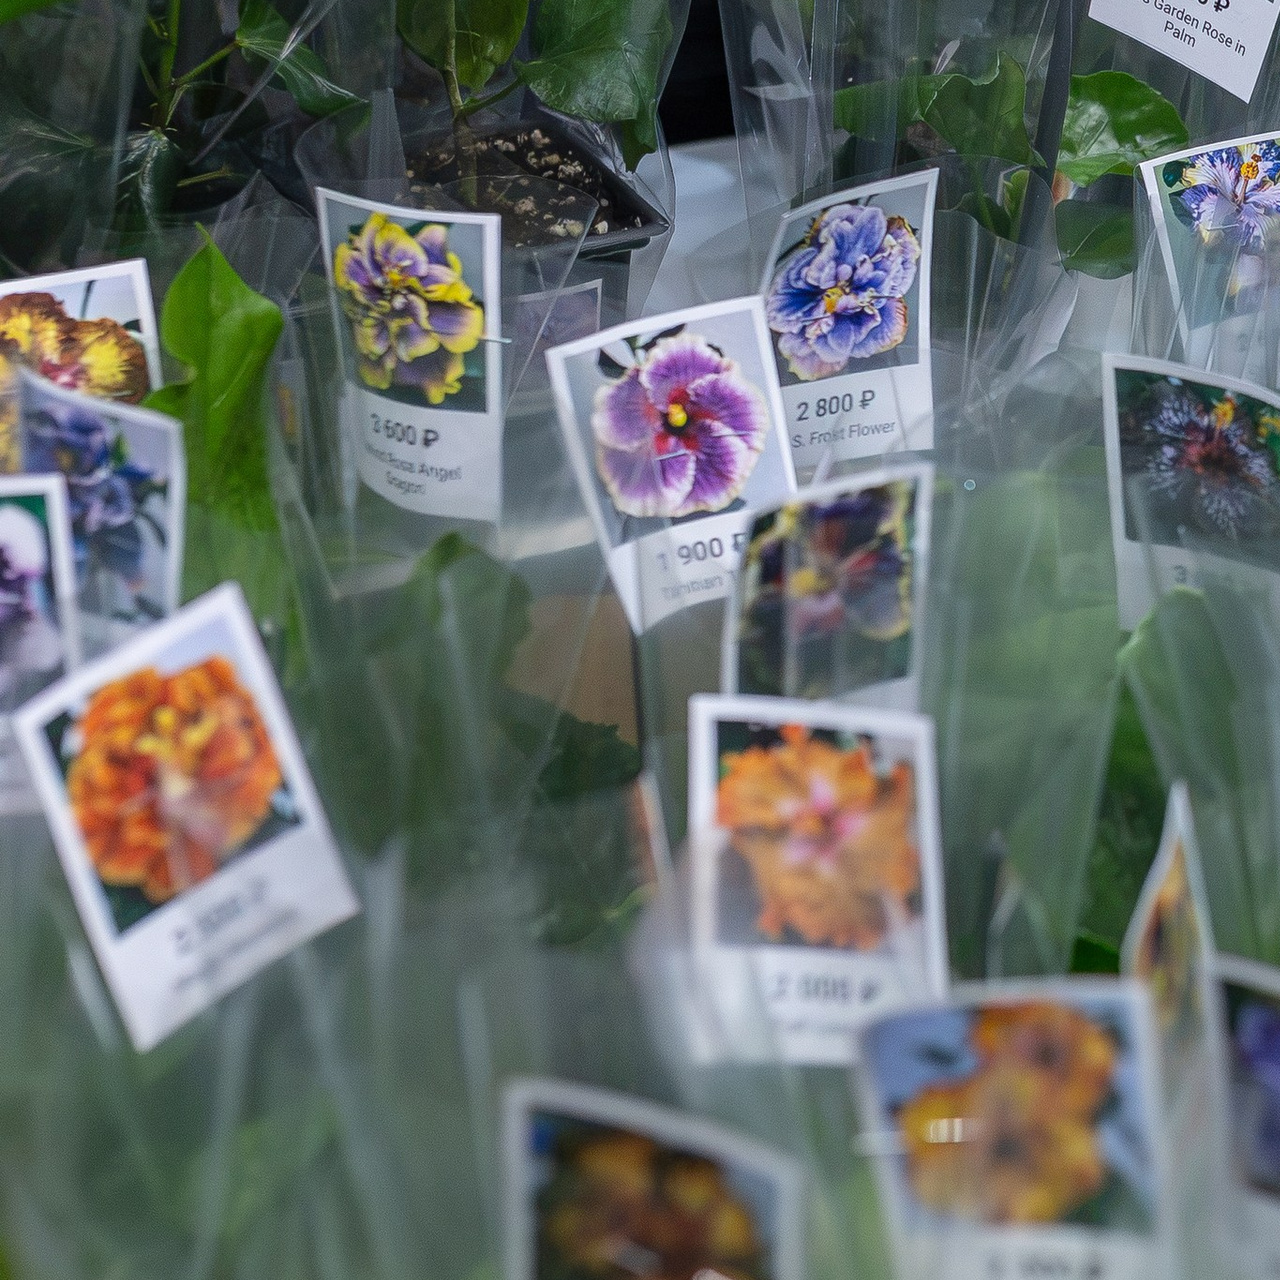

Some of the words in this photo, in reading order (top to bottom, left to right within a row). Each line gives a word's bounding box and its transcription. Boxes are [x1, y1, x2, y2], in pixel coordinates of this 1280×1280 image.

[1163, 20, 1197, 48] Palm
[1202, 20, 1233, 49] Rose
[1234, 39, 1247, 57] in
[796, 401, 810, 422] 2
[815, 393, 854, 417] 800
[858, 389, 875, 410] ₽
[848, 421, 896, 439] Flower
[677, 537, 724, 565] 900
